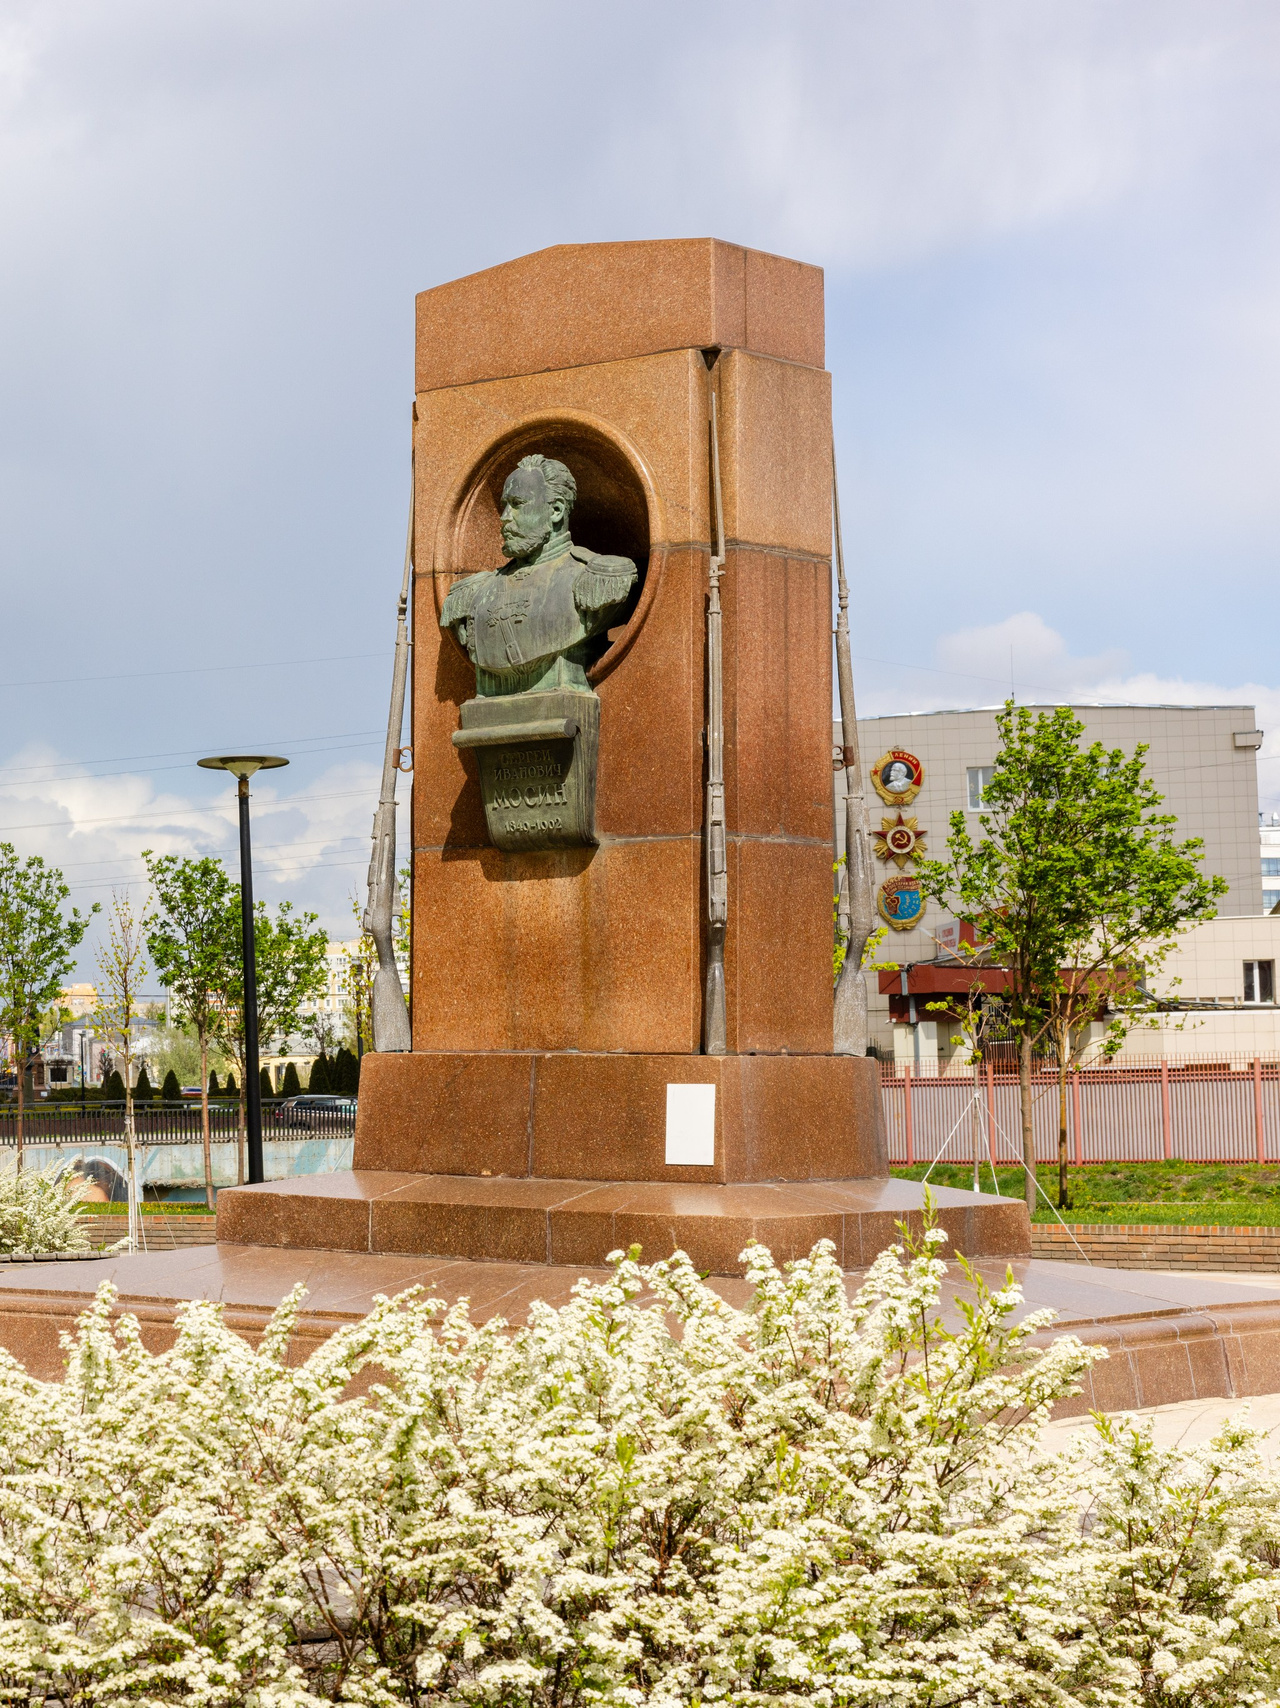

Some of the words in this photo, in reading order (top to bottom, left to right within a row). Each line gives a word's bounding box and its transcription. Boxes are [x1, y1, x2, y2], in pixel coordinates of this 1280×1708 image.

[894, 752, 918, 765] ЛЕНИН
[493, 763, 562, 781] ИВАНОВИЧ
[492, 783, 568, 811] МОСИН
